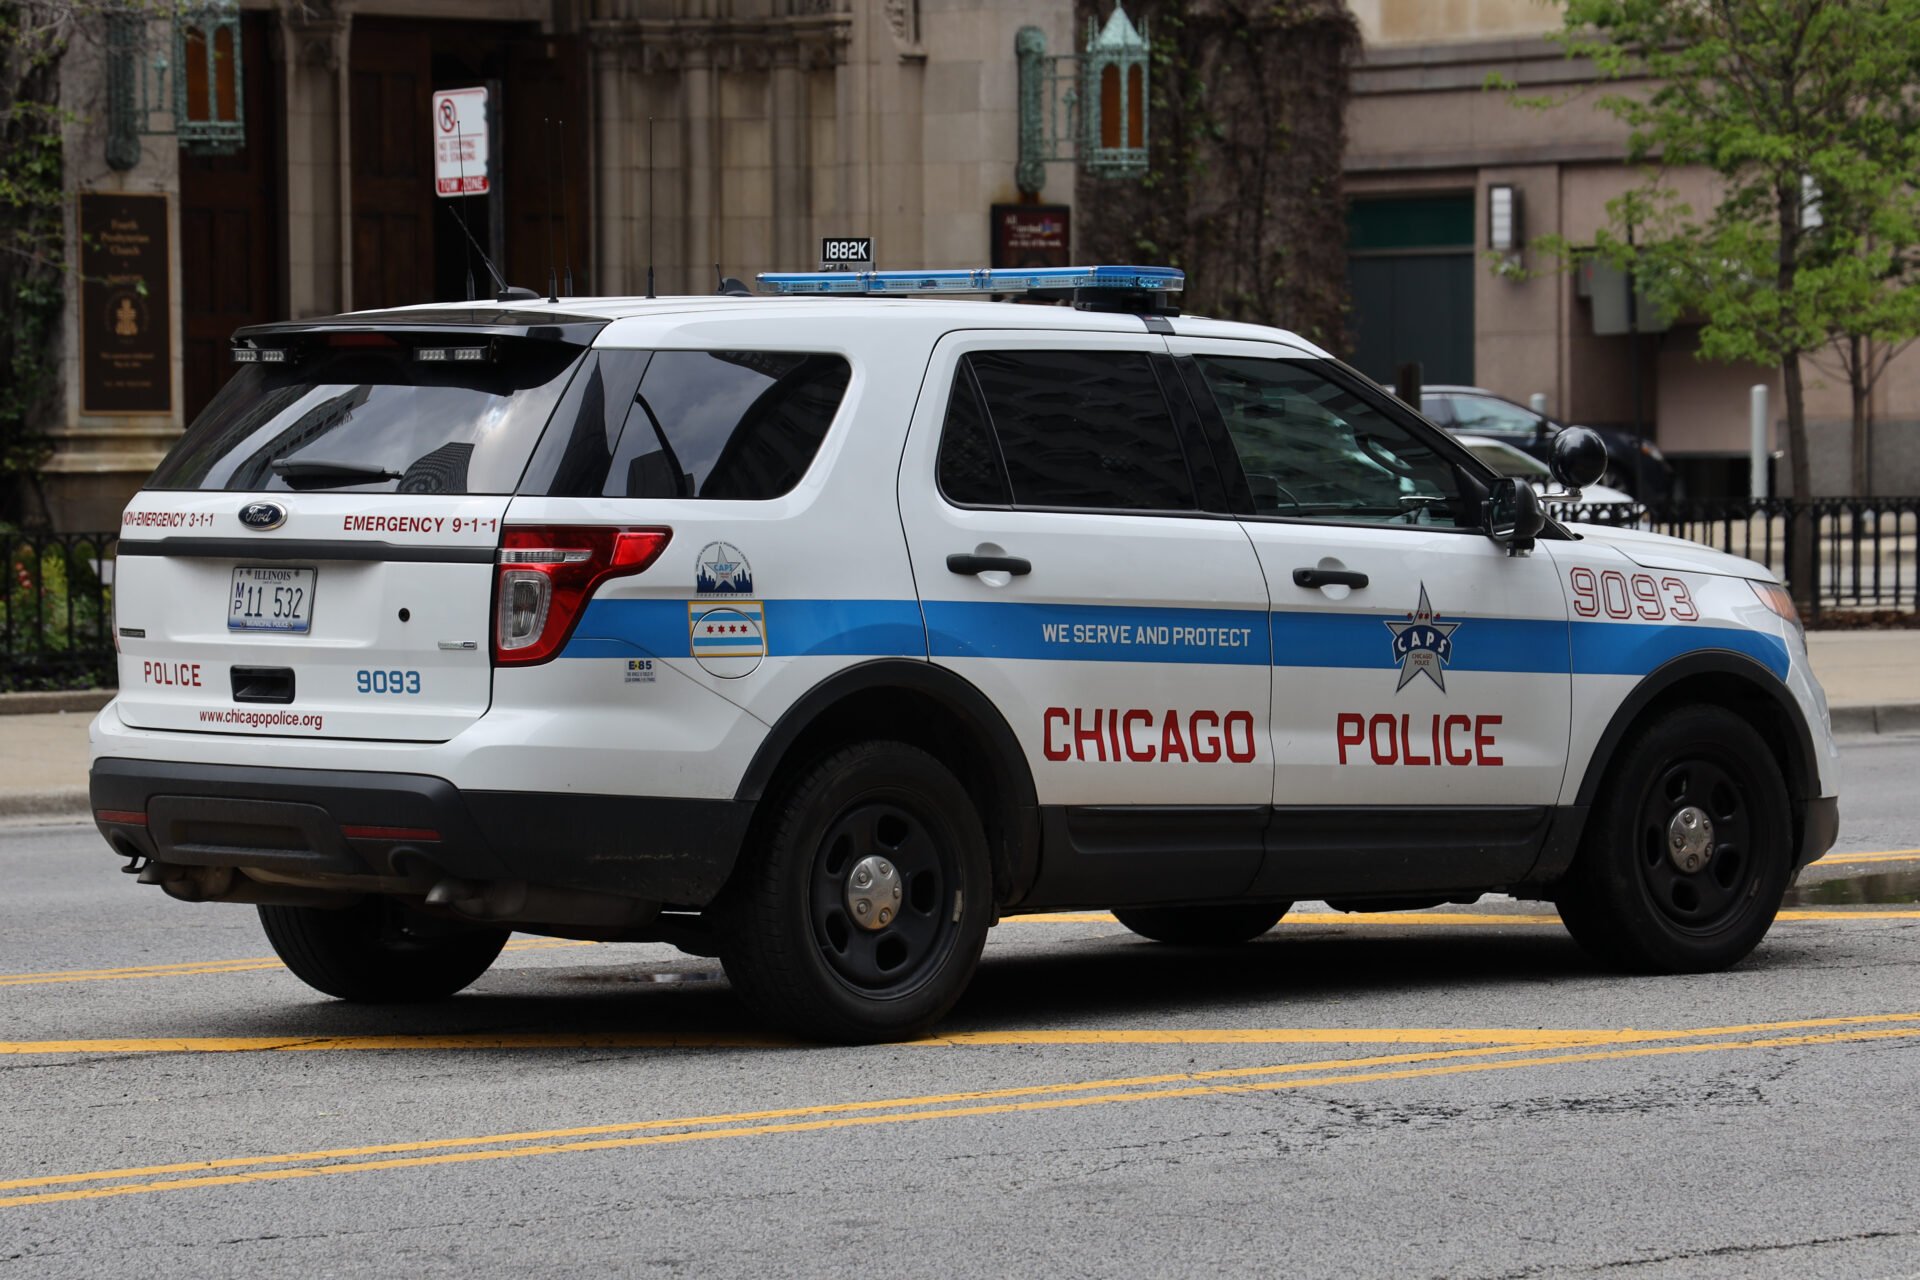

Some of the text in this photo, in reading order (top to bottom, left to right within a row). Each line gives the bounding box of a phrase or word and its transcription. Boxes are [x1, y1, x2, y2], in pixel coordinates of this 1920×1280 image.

[440, 178, 458, 192] TOW
[123, 511, 215, 528] NON-EMERGENCY 3-1-1
[245, 505, 272, 523] Ford
[343, 515, 497, 533] EMERGENCY 9-1-1
[254, 570, 292, 581] ILLINOIS
[244, 586, 303, 619] 11 532
[1570, 567, 1699, 621] 9093
[1042, 623, 1252, 647] WE SERVE AND PROTECT
[1397, 631, 1447, 653] CAPS
[143, 660, 421, 695] POLICE 9093
[199, 709, 323, 731] www.chicagopolice.org
[1043, 706, 1504, 766] CHICAGO POLICE
